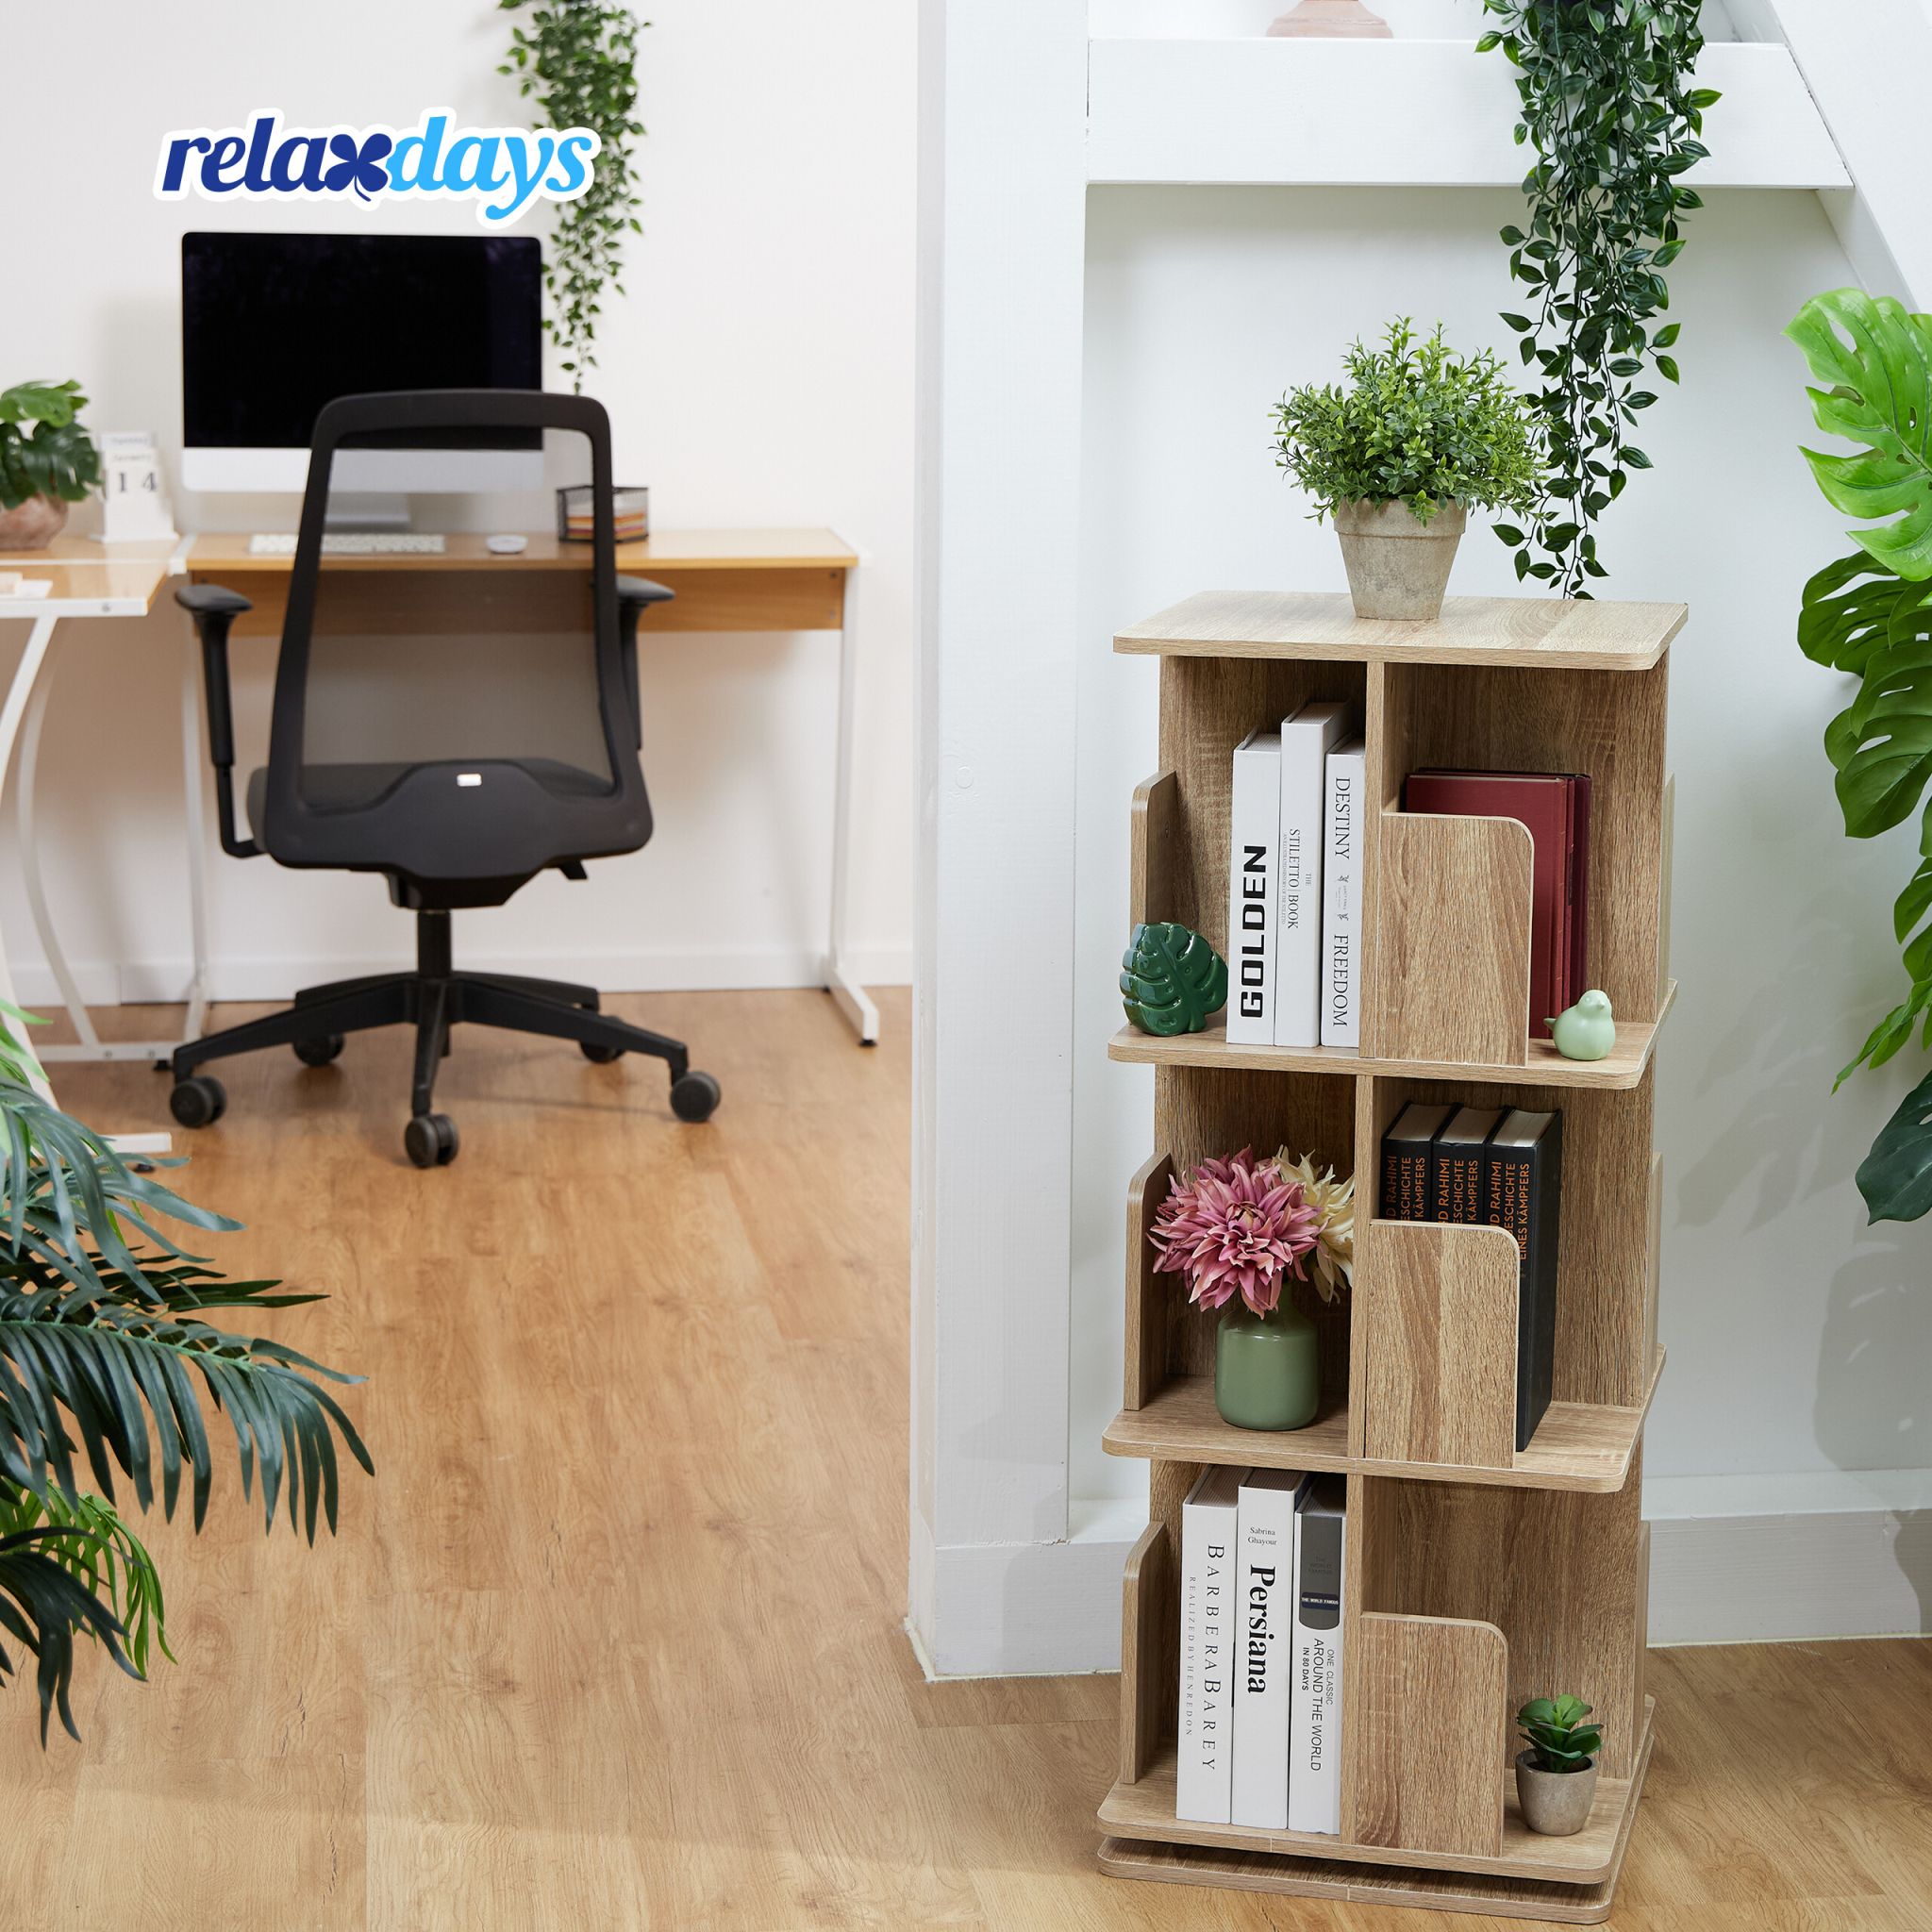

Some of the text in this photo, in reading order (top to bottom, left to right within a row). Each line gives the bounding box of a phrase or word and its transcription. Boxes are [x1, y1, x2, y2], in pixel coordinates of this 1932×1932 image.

[1335, 777, 1351, 860] DESTINY
[1288, 829, 1301, 929] STILETTO BOOK
[1241, 845, 1267, 1018] GOLDEN
[1332, 934, 1349, 1027] FREEDOM
[1386, 1156, 1397, 1204] RAHIMI
[1401, 1157, 1411, 1221] ESCHICHTE
[1415, 1157, 1425, 1218] KÄMPFERS
[1439, 1158, 1450, 1207] RAHIMI
[1454, 1159, 1464, 1224] ESCHICHTE
[1467, 1159, 1478, 1221] KÄMPFERS
[1491, 1161, 1502, 1209] RAHIMI
[1517, 1163, 1530, 1260] EINES KÄMPFERS
[1247, 1536, 1277, 1546] Ghayour
[1250, 1526, 1275, 1536] Sabrina
[1188, 1576, 1196, 1641] REALIZED
[1247, 1563, 1276, 1694] Persiana
[1186, 1666, 1194, 1736] HENREDON
[1301, 1647, 1309, 1691] IN 80 DAYS
[1325, 1672, 1334, 1706] CLASSIC
[1310, 1638, 1324, 1772] AROUND THE WORLD
